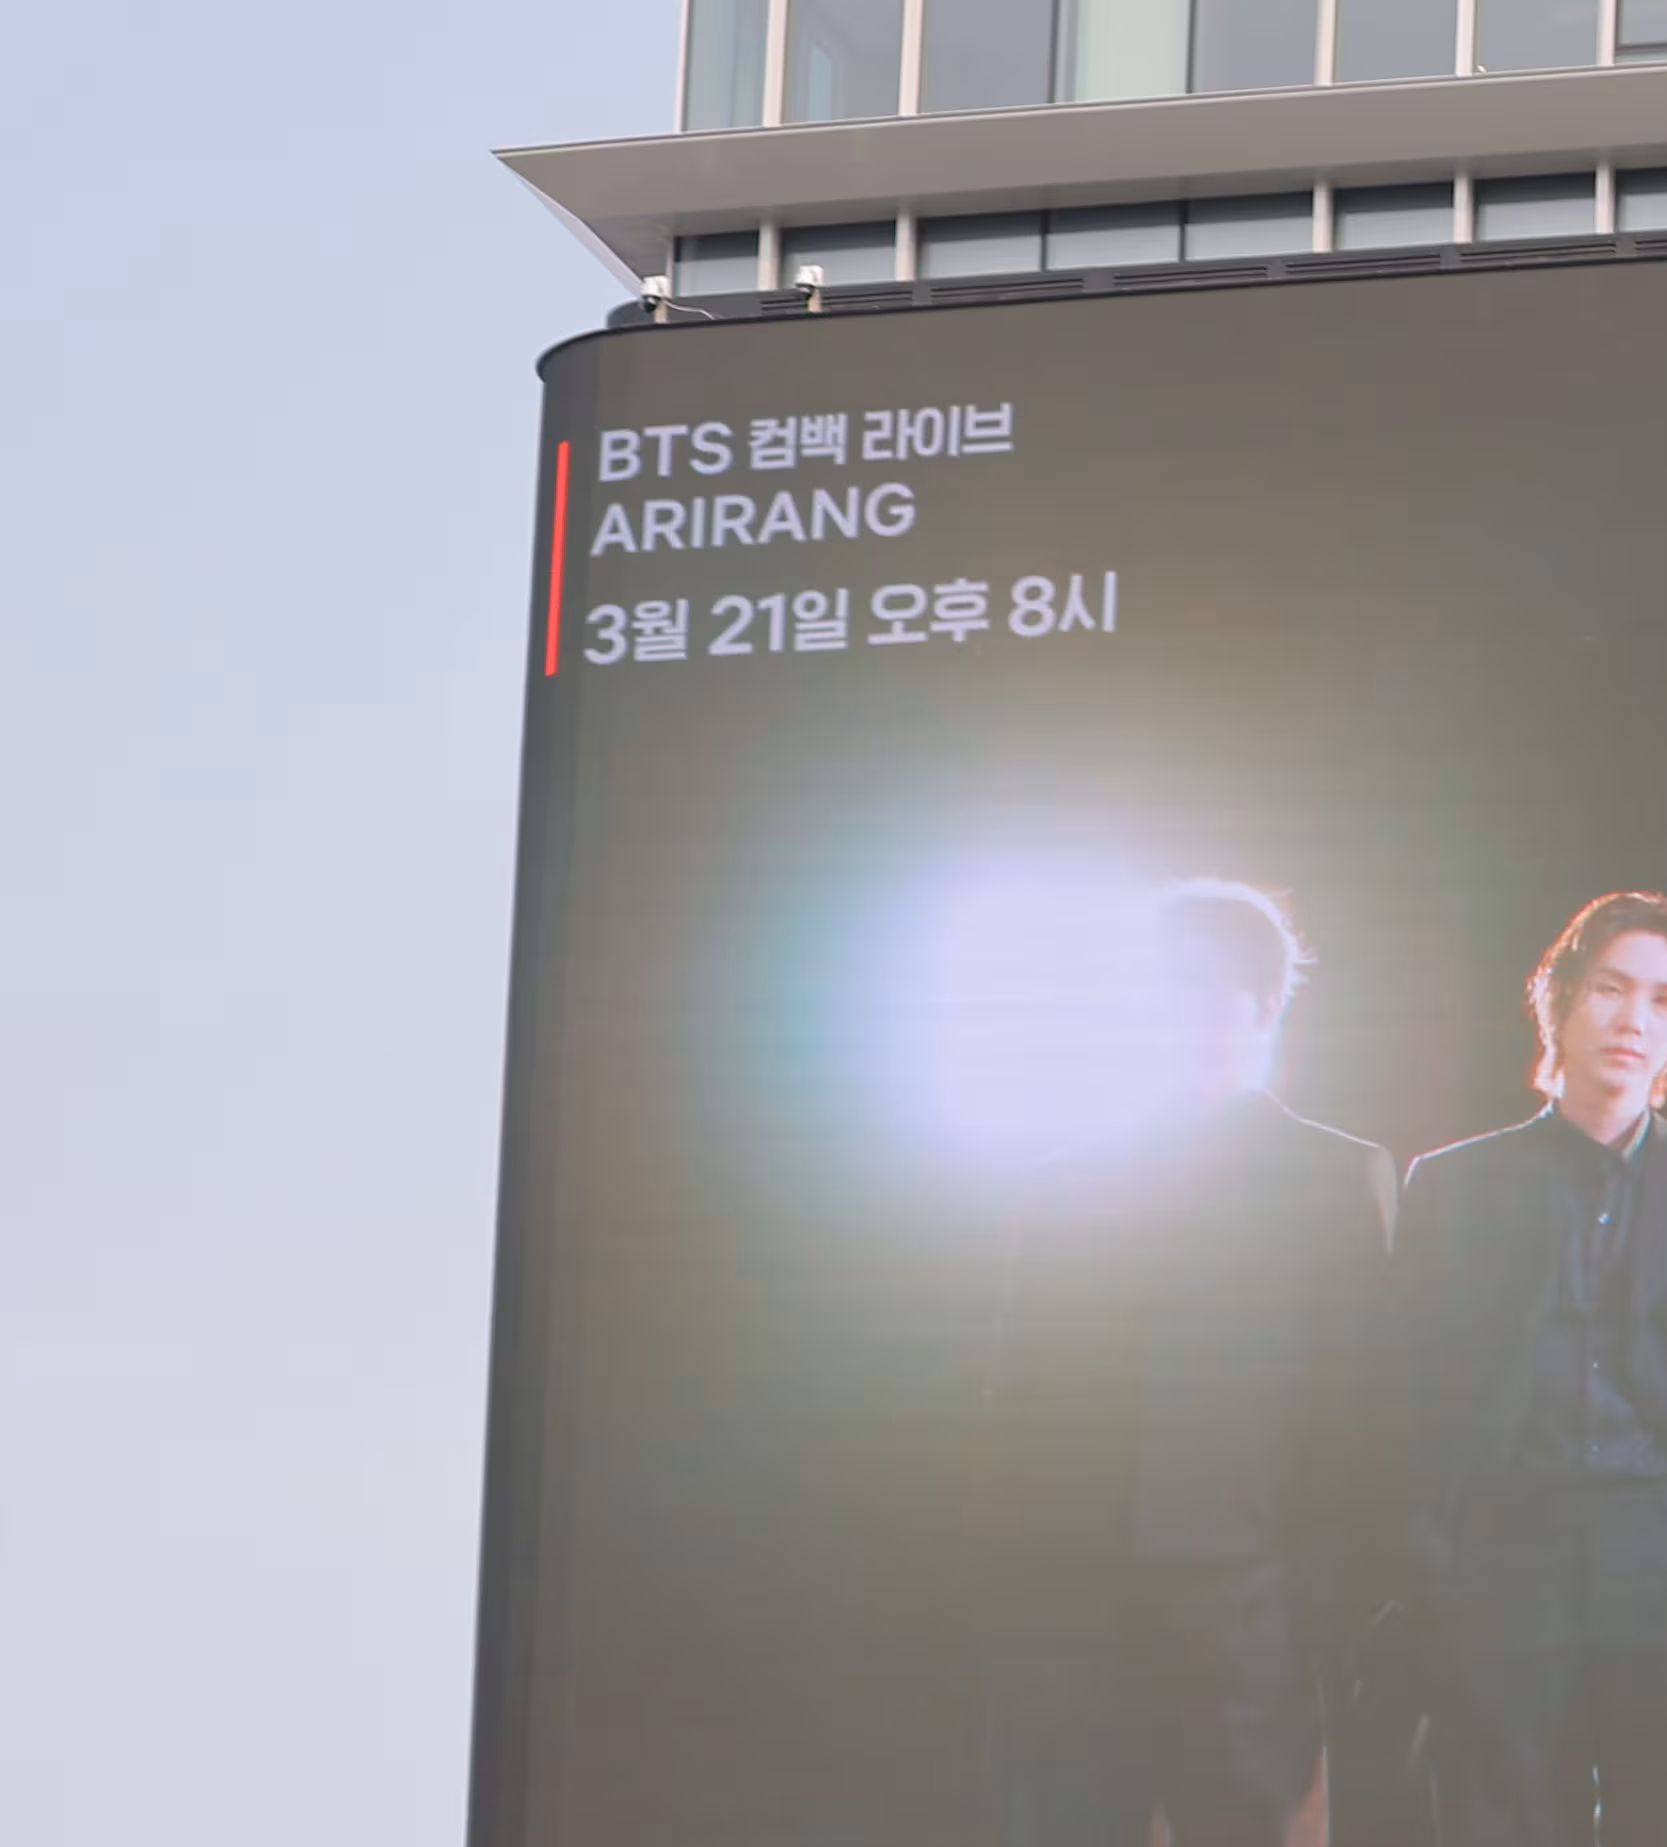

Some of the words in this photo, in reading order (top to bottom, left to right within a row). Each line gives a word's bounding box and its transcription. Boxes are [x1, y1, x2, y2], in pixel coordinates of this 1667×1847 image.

[598, 421, 733, 482] BTS
[749, 413, 848, 470] 컴백
[862, 402, 1013, 460] 라이브
[590, 482, 916, 556] ARIRANG
[583, 598, 690, 665] 3월
[708, 588, 850, 656] 21일
[867, 578, 990, 645] 오후
[1008, 571, 1118, 637] 8시
